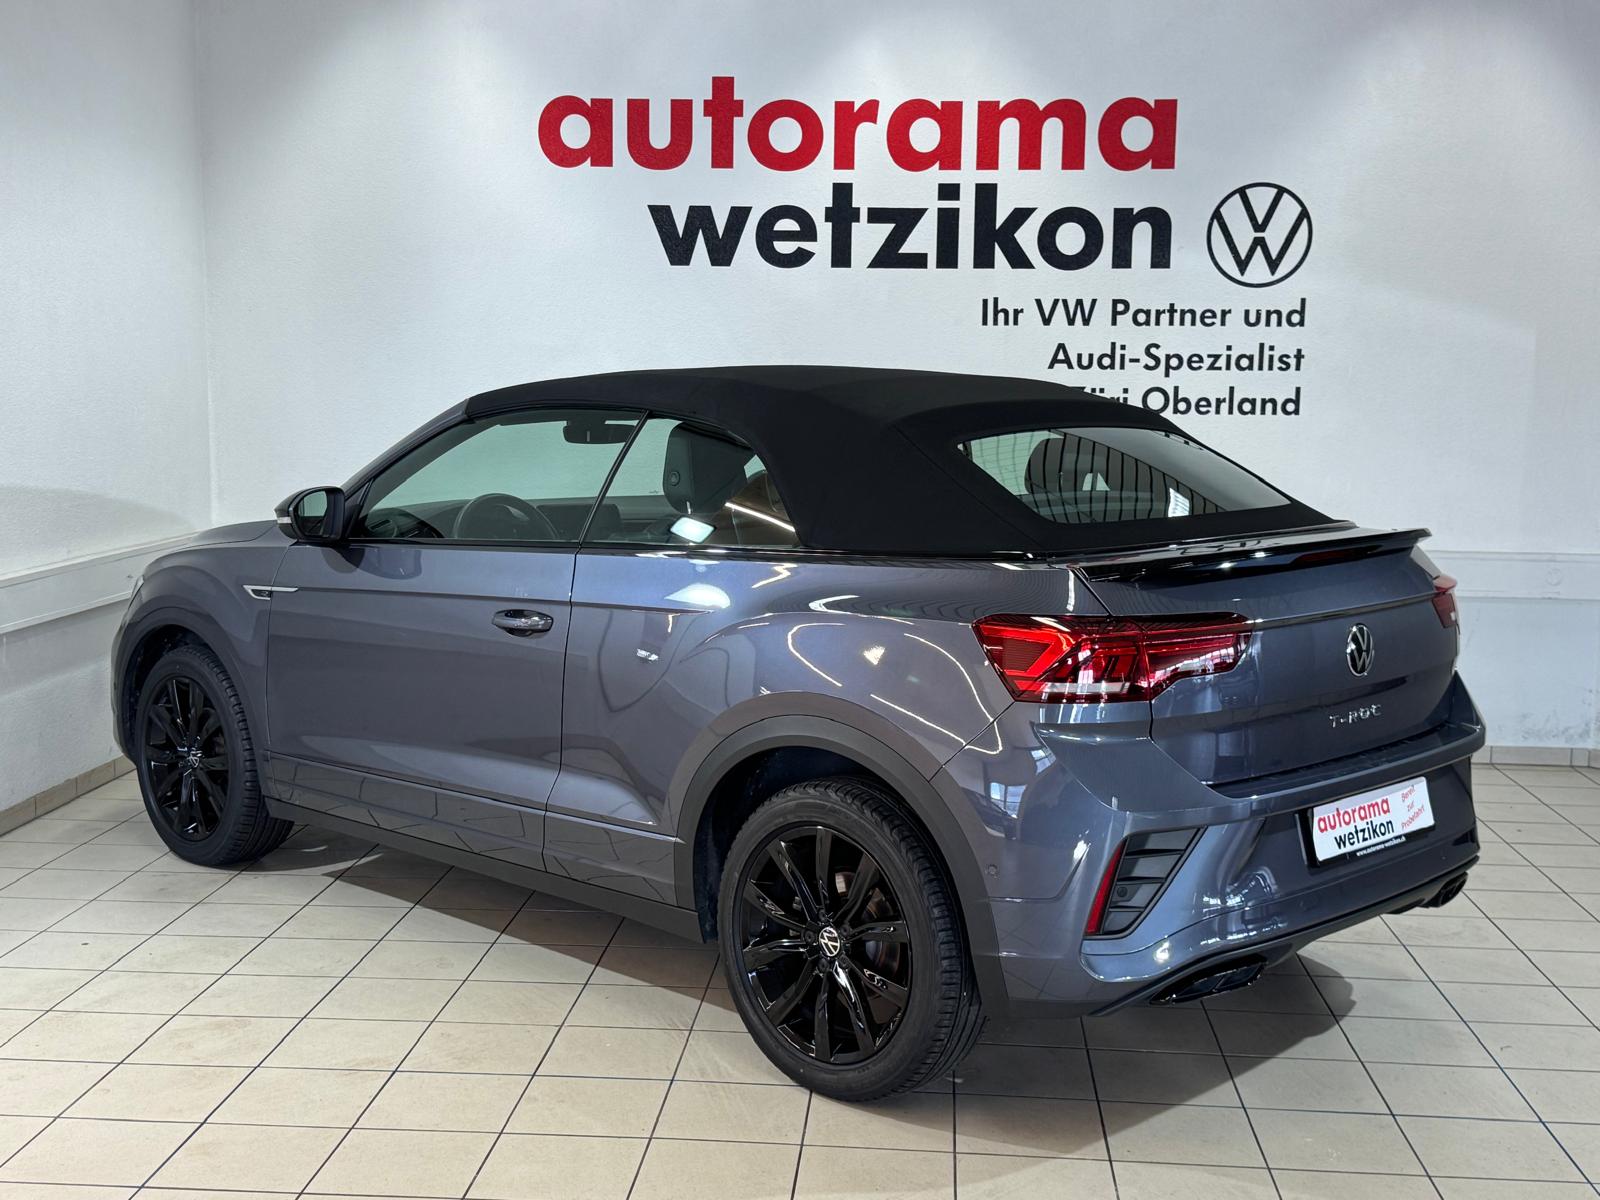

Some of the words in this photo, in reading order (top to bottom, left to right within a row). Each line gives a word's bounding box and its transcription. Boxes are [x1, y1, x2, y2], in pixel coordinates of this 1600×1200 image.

[538, 77, 1178, 172] autorama
[648, 183, 1172, 270] wetzikon
[981, 298, 1024, 327] Ihr
[1035, 298, 1098, 327] VW
[1111, 298, 1232, 328] Partner
[1244, 297, 1308, 328] und
[1048, 342, 1305, 378] Audi-Spezialist
[1141, 385, 1302, 416] Oberland
[1329, 704, 1381, 728] T-ROC
[1317, 798, 1391, 833] autorama
[1334, 820, 1395, 850] wetzikon
